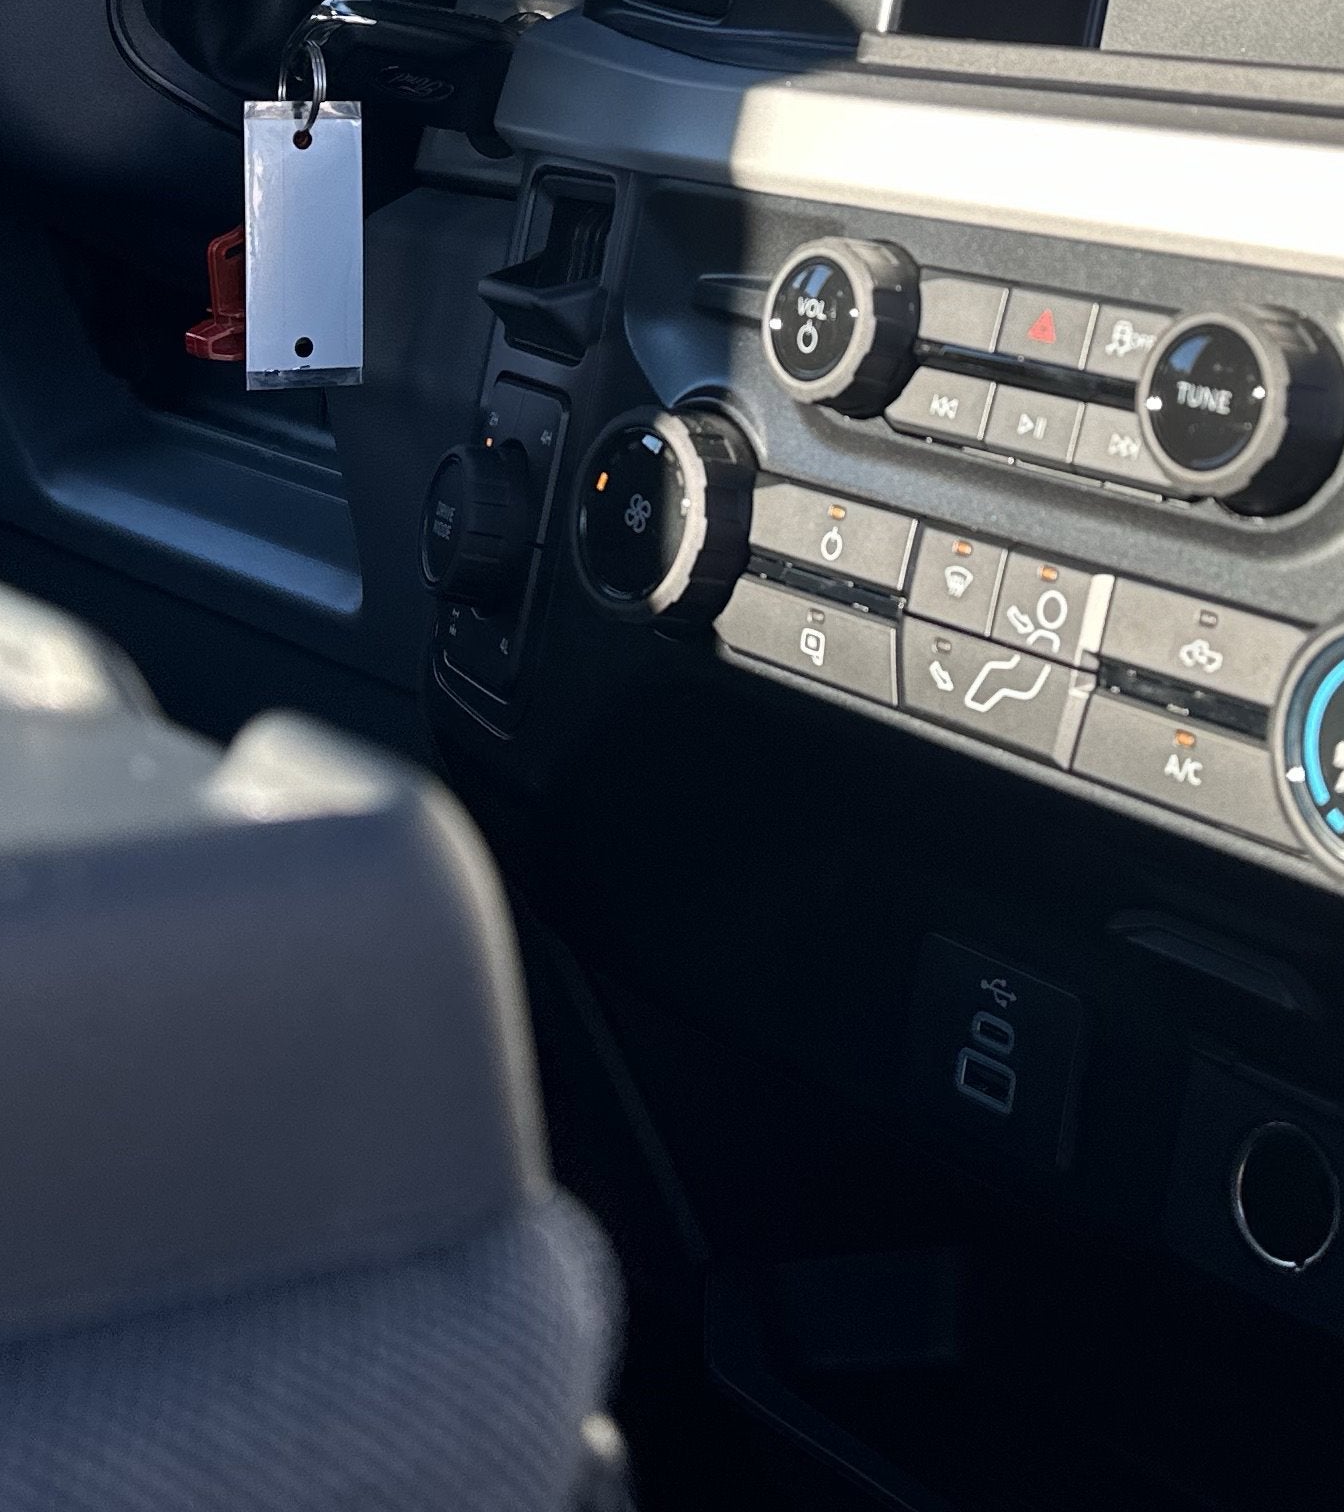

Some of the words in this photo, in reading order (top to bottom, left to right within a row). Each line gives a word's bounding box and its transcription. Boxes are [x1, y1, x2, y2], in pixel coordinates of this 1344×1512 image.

[798, 296, 827, 321] VOL
[1176, 381, 1233, 415] TUNE
[1164, 754, 1203, 786] A/C
